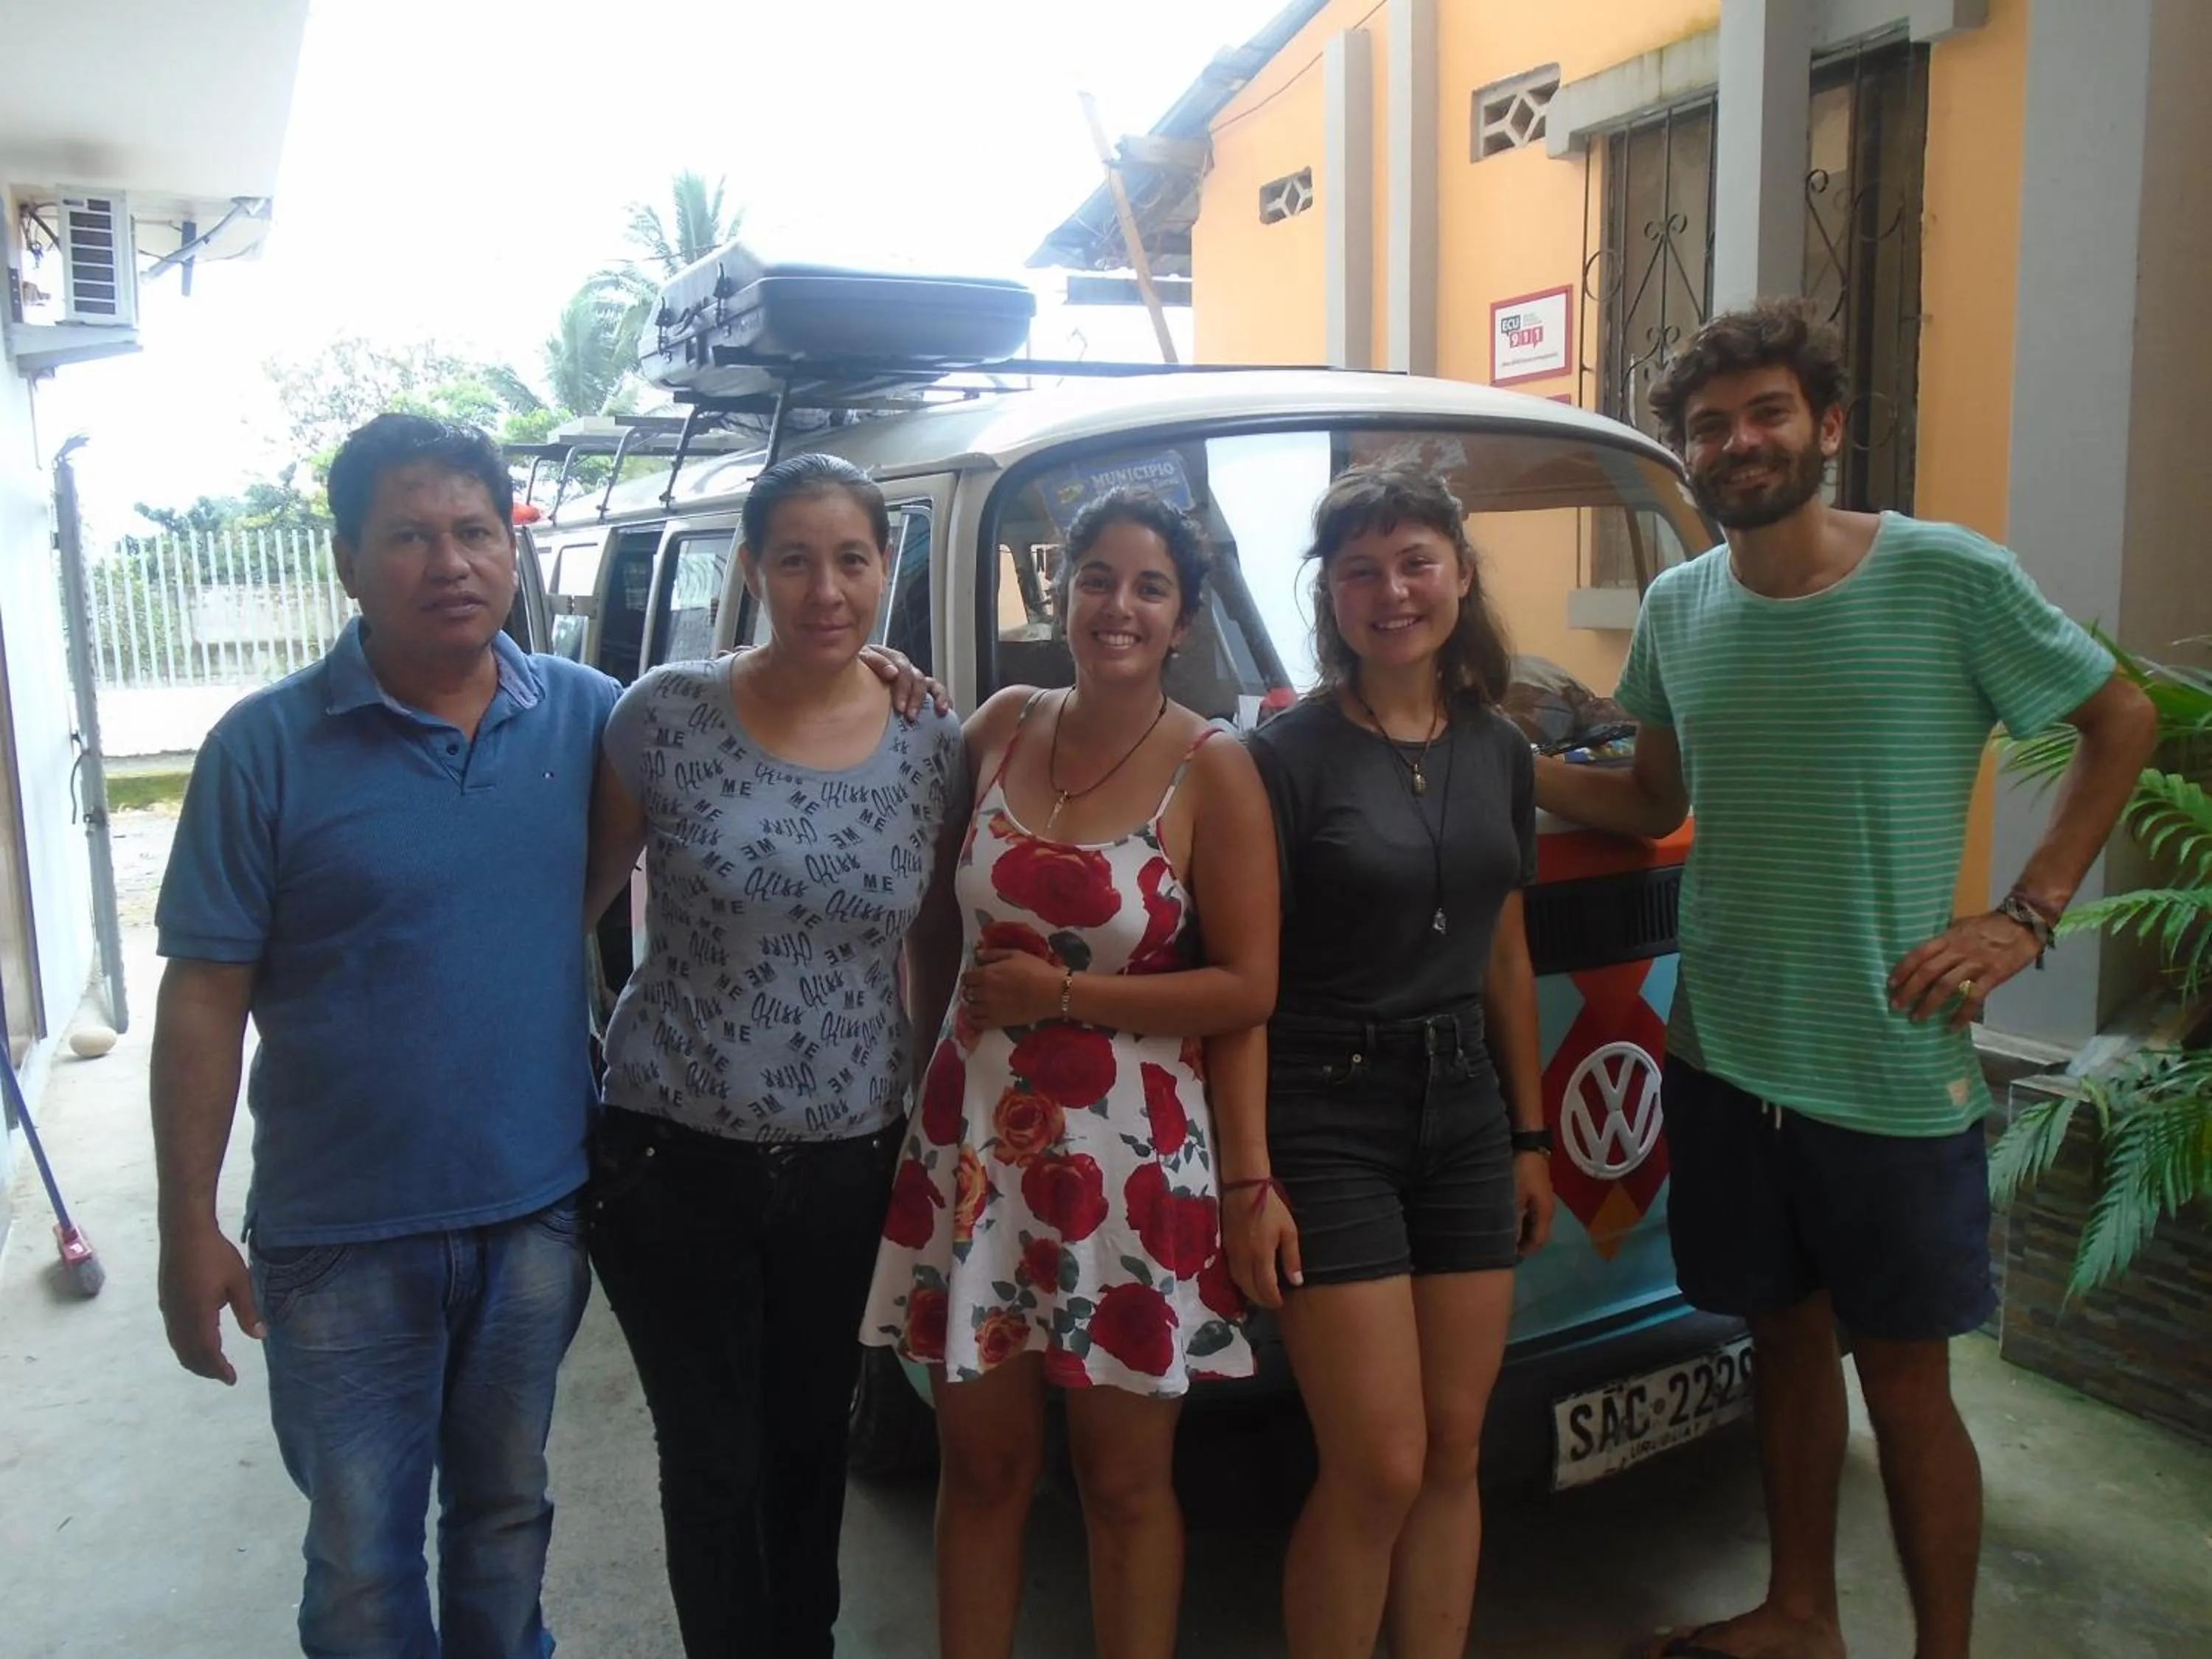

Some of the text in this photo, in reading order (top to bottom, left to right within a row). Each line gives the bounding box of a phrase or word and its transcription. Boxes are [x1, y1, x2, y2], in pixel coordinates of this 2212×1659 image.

[1502, 317, 1520, 330] ECU
[1511, 329, 1540, 346] 911
[1090, 462, 1175, 487] MUNICIPIO
[655, 728, 685, 747] ME
[718, 736, 748, 760] ME
[675, 758, 725, 796] Kiss
[899, 760, 922, 785] ME
[720, 779, 753, 799] ME
[821, 782, 870, 808] Kiss
[872, 782, 908, 819] Kiss
[694, 799, 723, 821] ME
[789, 790, 820, 815] ME
[858, 808, 886, 833] ME
[741, 837, 776, 860] ME
[829, 827, 863, 849] ME
[702, 850, 735, 877] ME
[804, 853, 861, 886] Kiss
[744, 866, 808, 902] Kiss
[863, 873, 894, 893] ME
[710, 897, 745, 914] ME
[787, 904, 822, 929] ME
[825, 889, 885, 922] Kiss
[715, 973, 743, 1001] ME
[799, 970, 845, 1011] Kiss
[751, 992, 807, 1029] Kiss
[722, 1020, 751, 1043] ME
[821, 1011, 860, 1047] Kiss
[787, 1031, 821, 1059] ME
[658, 1085, 684, 1107] ME
[1570, 1385, 1650, 1462] SAC
